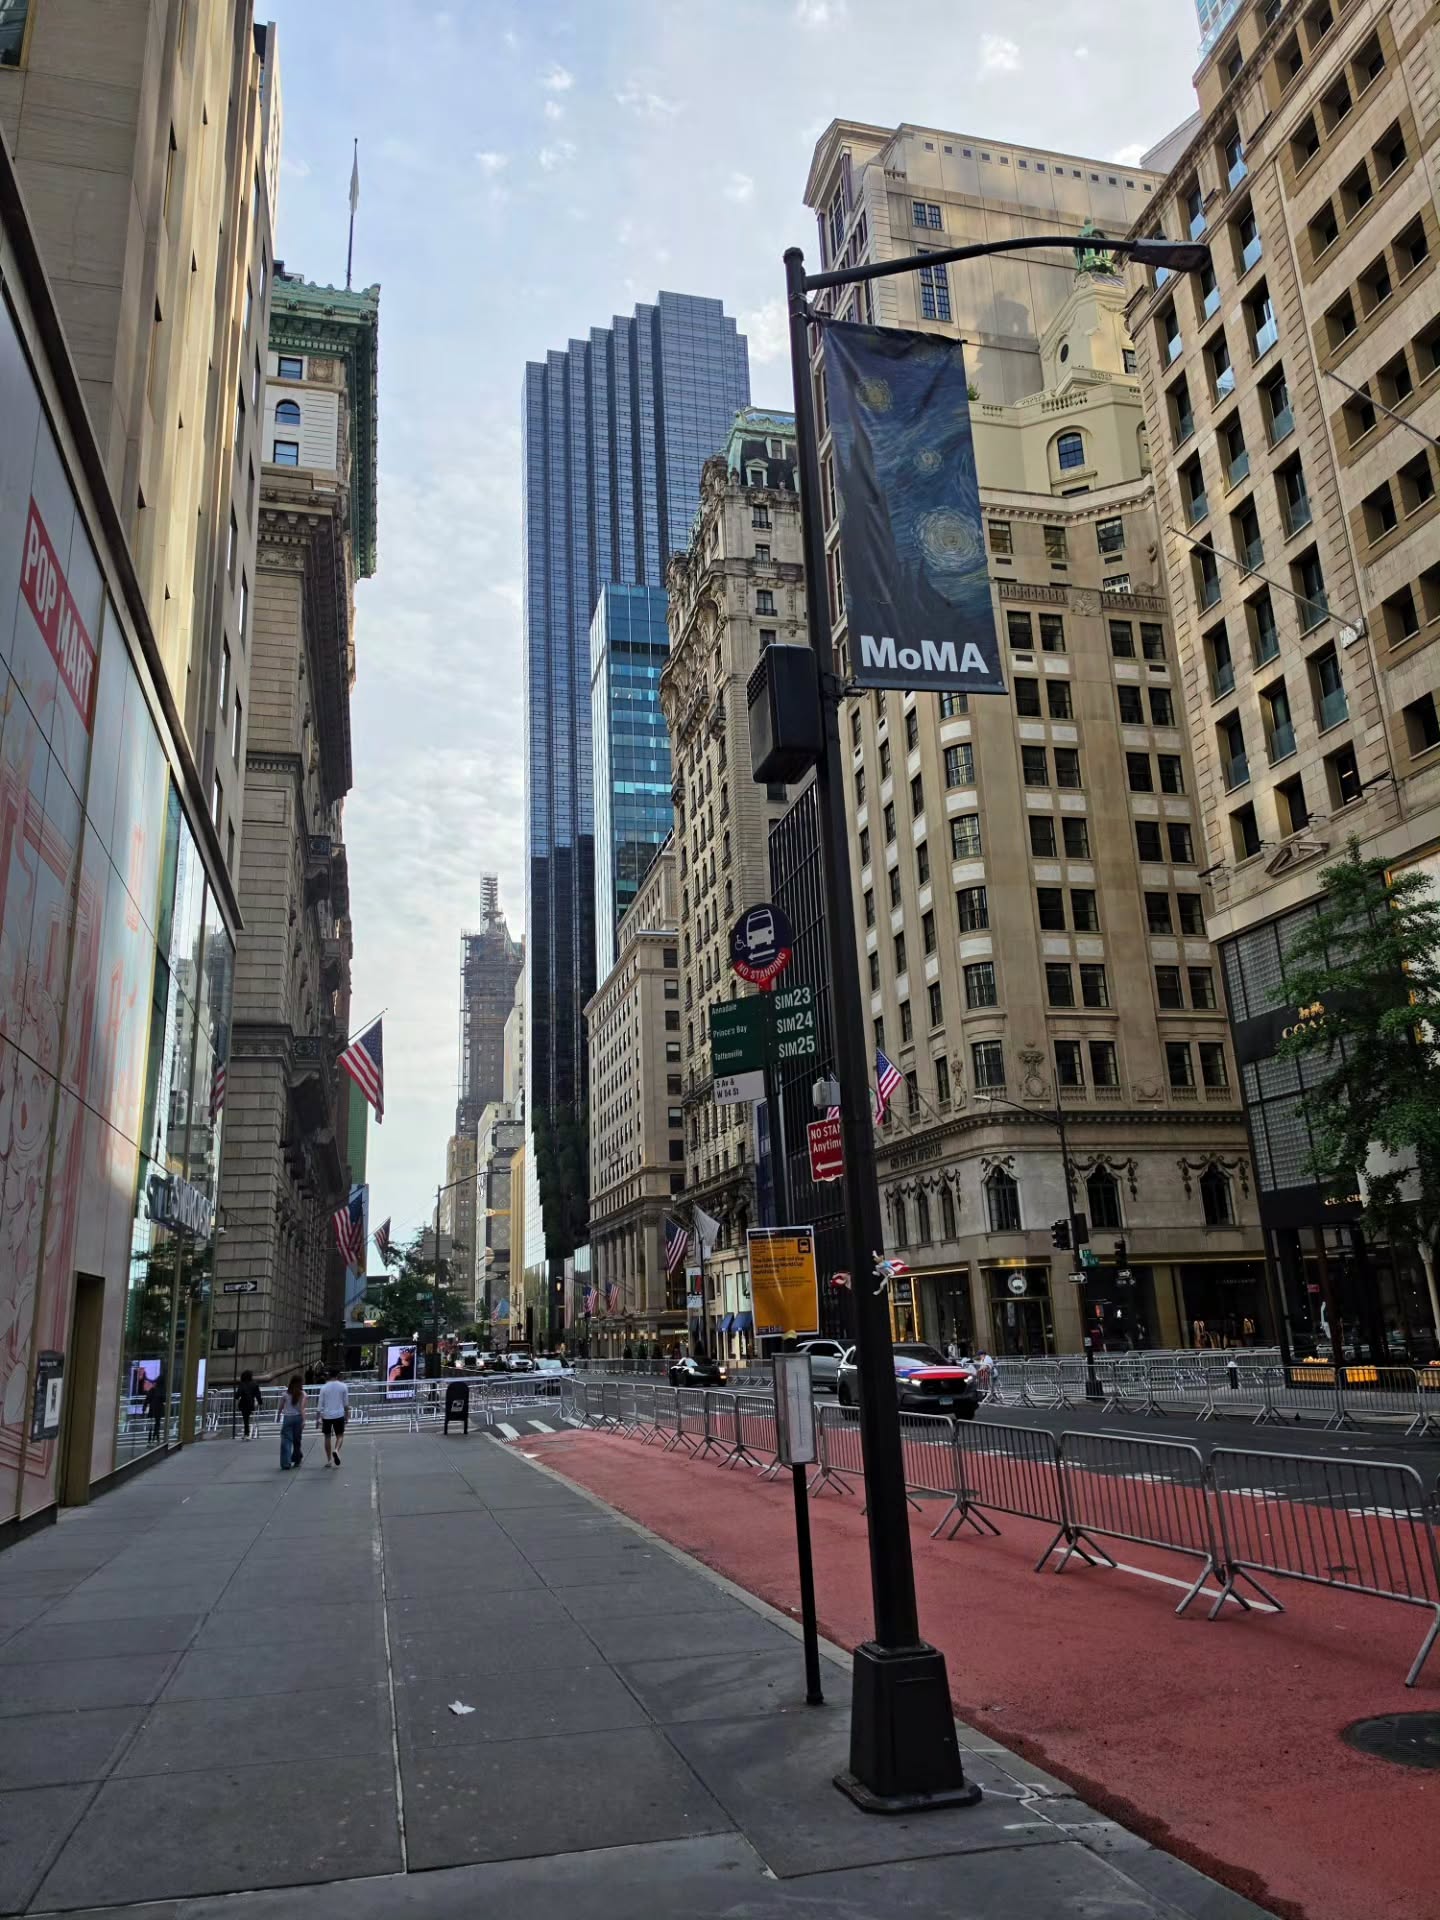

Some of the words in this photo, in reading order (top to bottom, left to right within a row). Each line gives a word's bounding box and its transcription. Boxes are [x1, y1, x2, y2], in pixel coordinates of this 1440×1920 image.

[24, 515, 58, 626] POP
[56, 591, 94, 714] MART
[860, 635, 990, 674] MoMA
[736, 962, 749, 976] NO
[750, 951, 786, 980] STANDING
[774, 986, 811, 1010] SIM23
[711, 1003, 737, 1016] Annadale
[776, 1010, 814, 1034] SIM24
[712, 1027, 736, 1039] Prince's
[736, 1025, 748, 1035] Bay
[778, 1035, 816, 1058] SIM25
[714, 1048, 743, 1061] Tottenville
[721, 1079, 729, 1088] Av
[716, 1089, 723, 1099] W
[810, 1127, 822, 1140] NO
[1324, 1193, 1362, 1207] COCH
